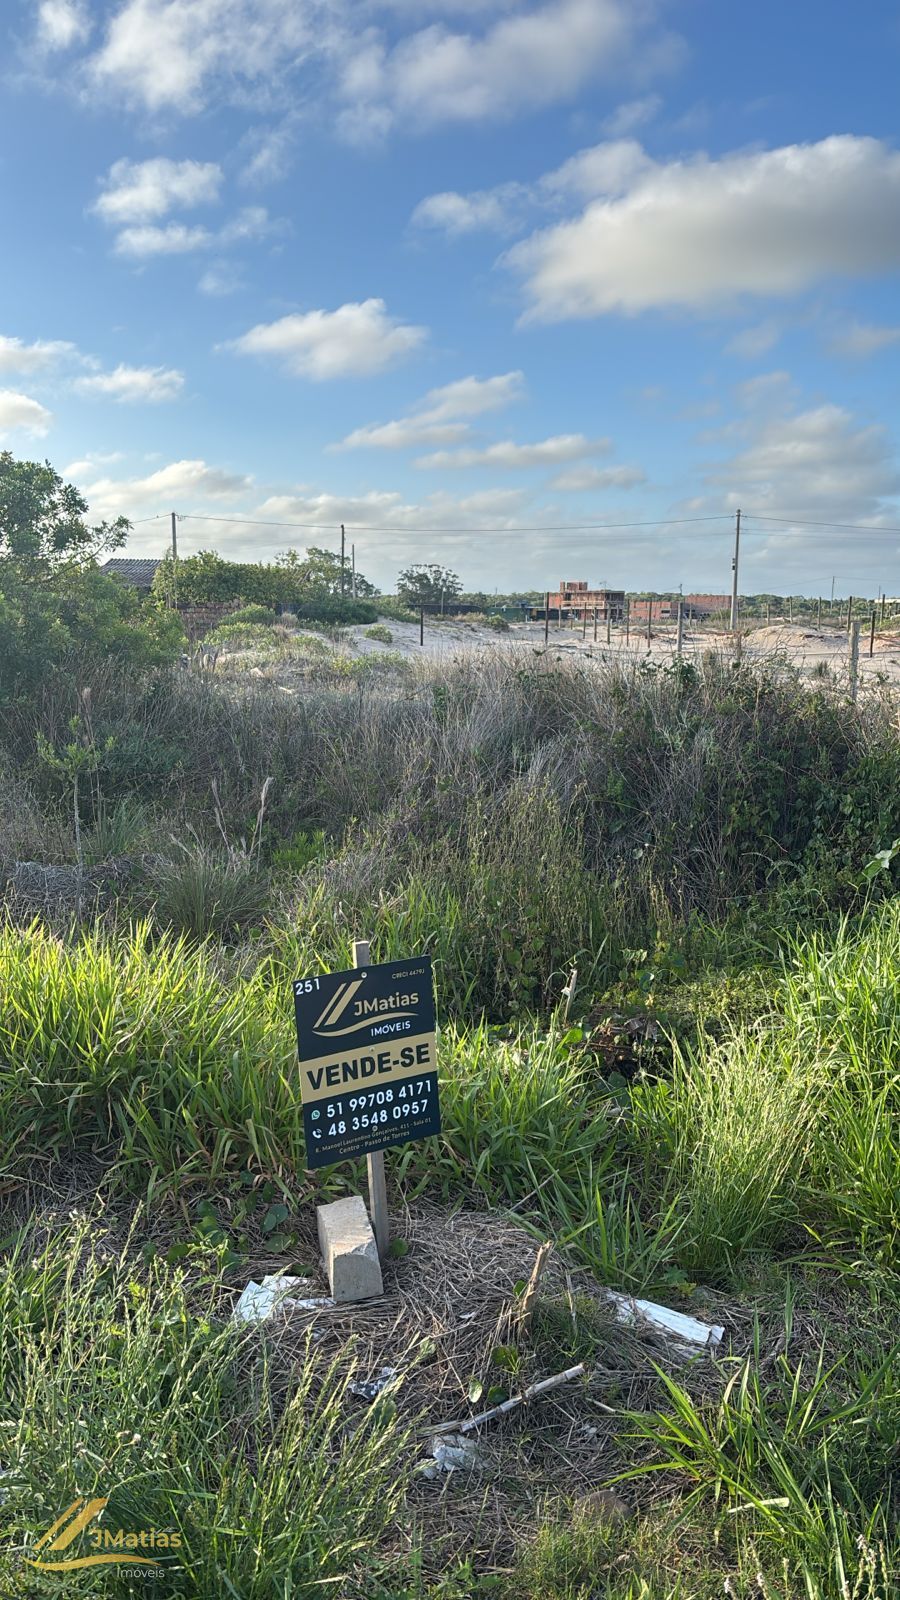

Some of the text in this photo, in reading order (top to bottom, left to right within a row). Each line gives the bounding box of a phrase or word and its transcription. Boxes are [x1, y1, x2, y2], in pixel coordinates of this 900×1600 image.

[295, 978, 320, 996] 251
[353, 992, 419, 1017] JMatias
[370, 1020, 411, 1037] IMÓVEIS
[306, 1043, 431, 1091] VENDE-SE
[326, 1080, 432, 1118] 51 99708 4171
[328, 1099, 429, 1137] 48 3548 0957
[322, 1141, 343, 1152] Manoel
[339, 1144, 360, 1154] Centro
[364, 1138, 382, 1147] Passo
[391, 1131, 410, 1140] Torres
